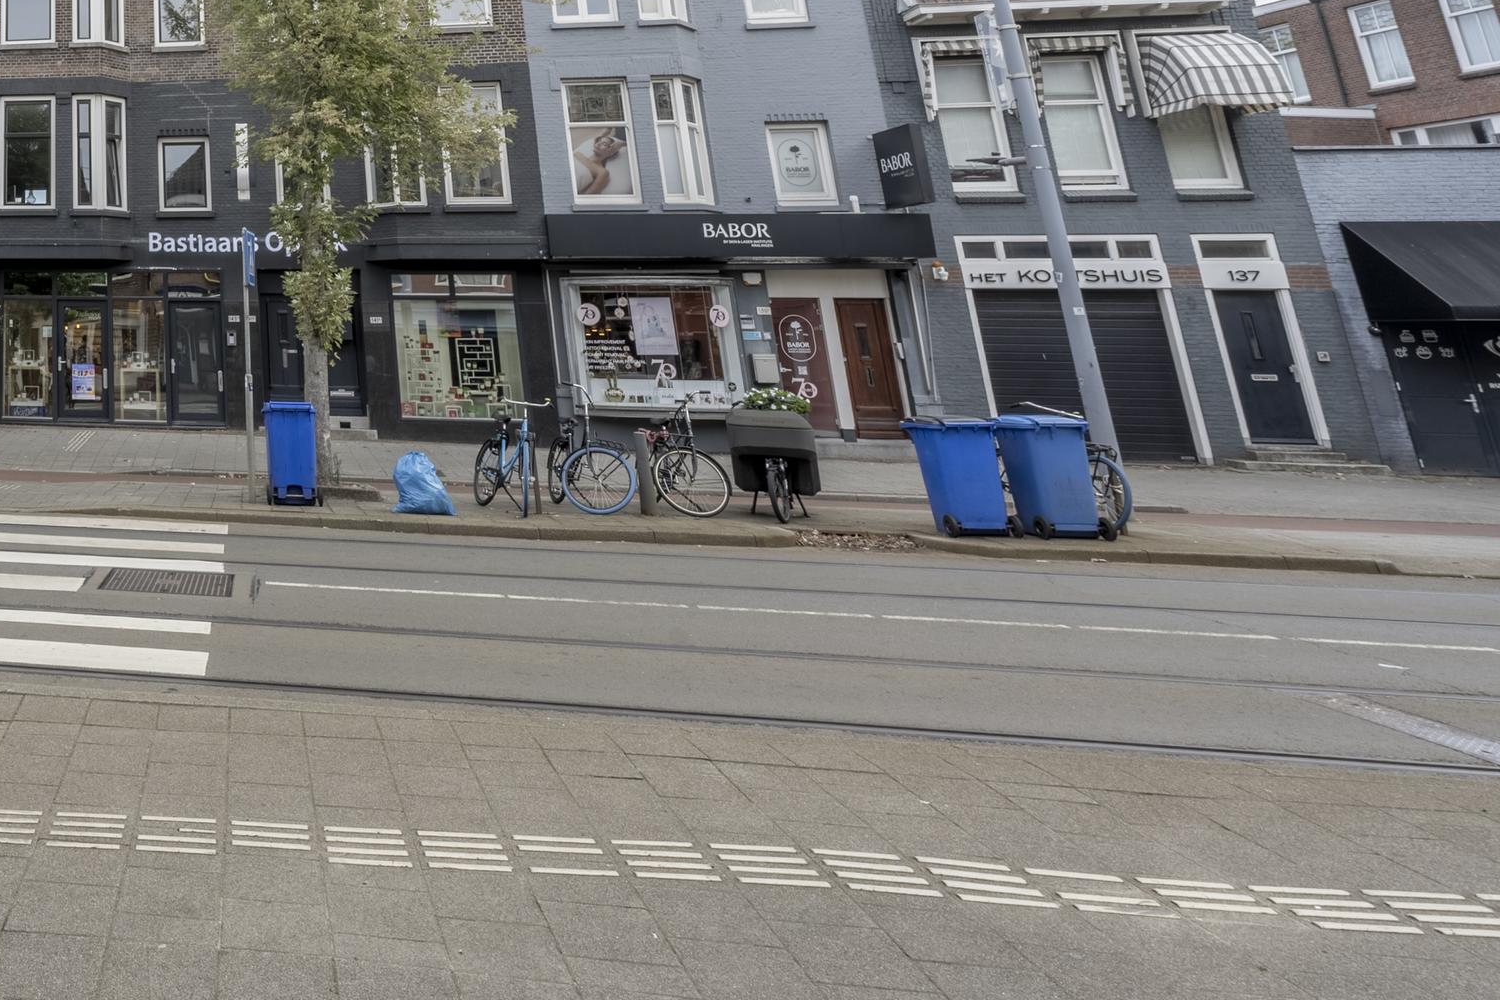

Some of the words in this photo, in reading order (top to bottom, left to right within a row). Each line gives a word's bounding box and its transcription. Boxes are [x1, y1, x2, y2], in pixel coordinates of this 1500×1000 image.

[880, 152, 913, 174] BABOR
[702, 223, 771, 238] BABOR
[970, 272, 1007, 283] HET
[1017, 269, 1163, 283] KOTSHUIS
[1228, 270, 1260, 282] 137
